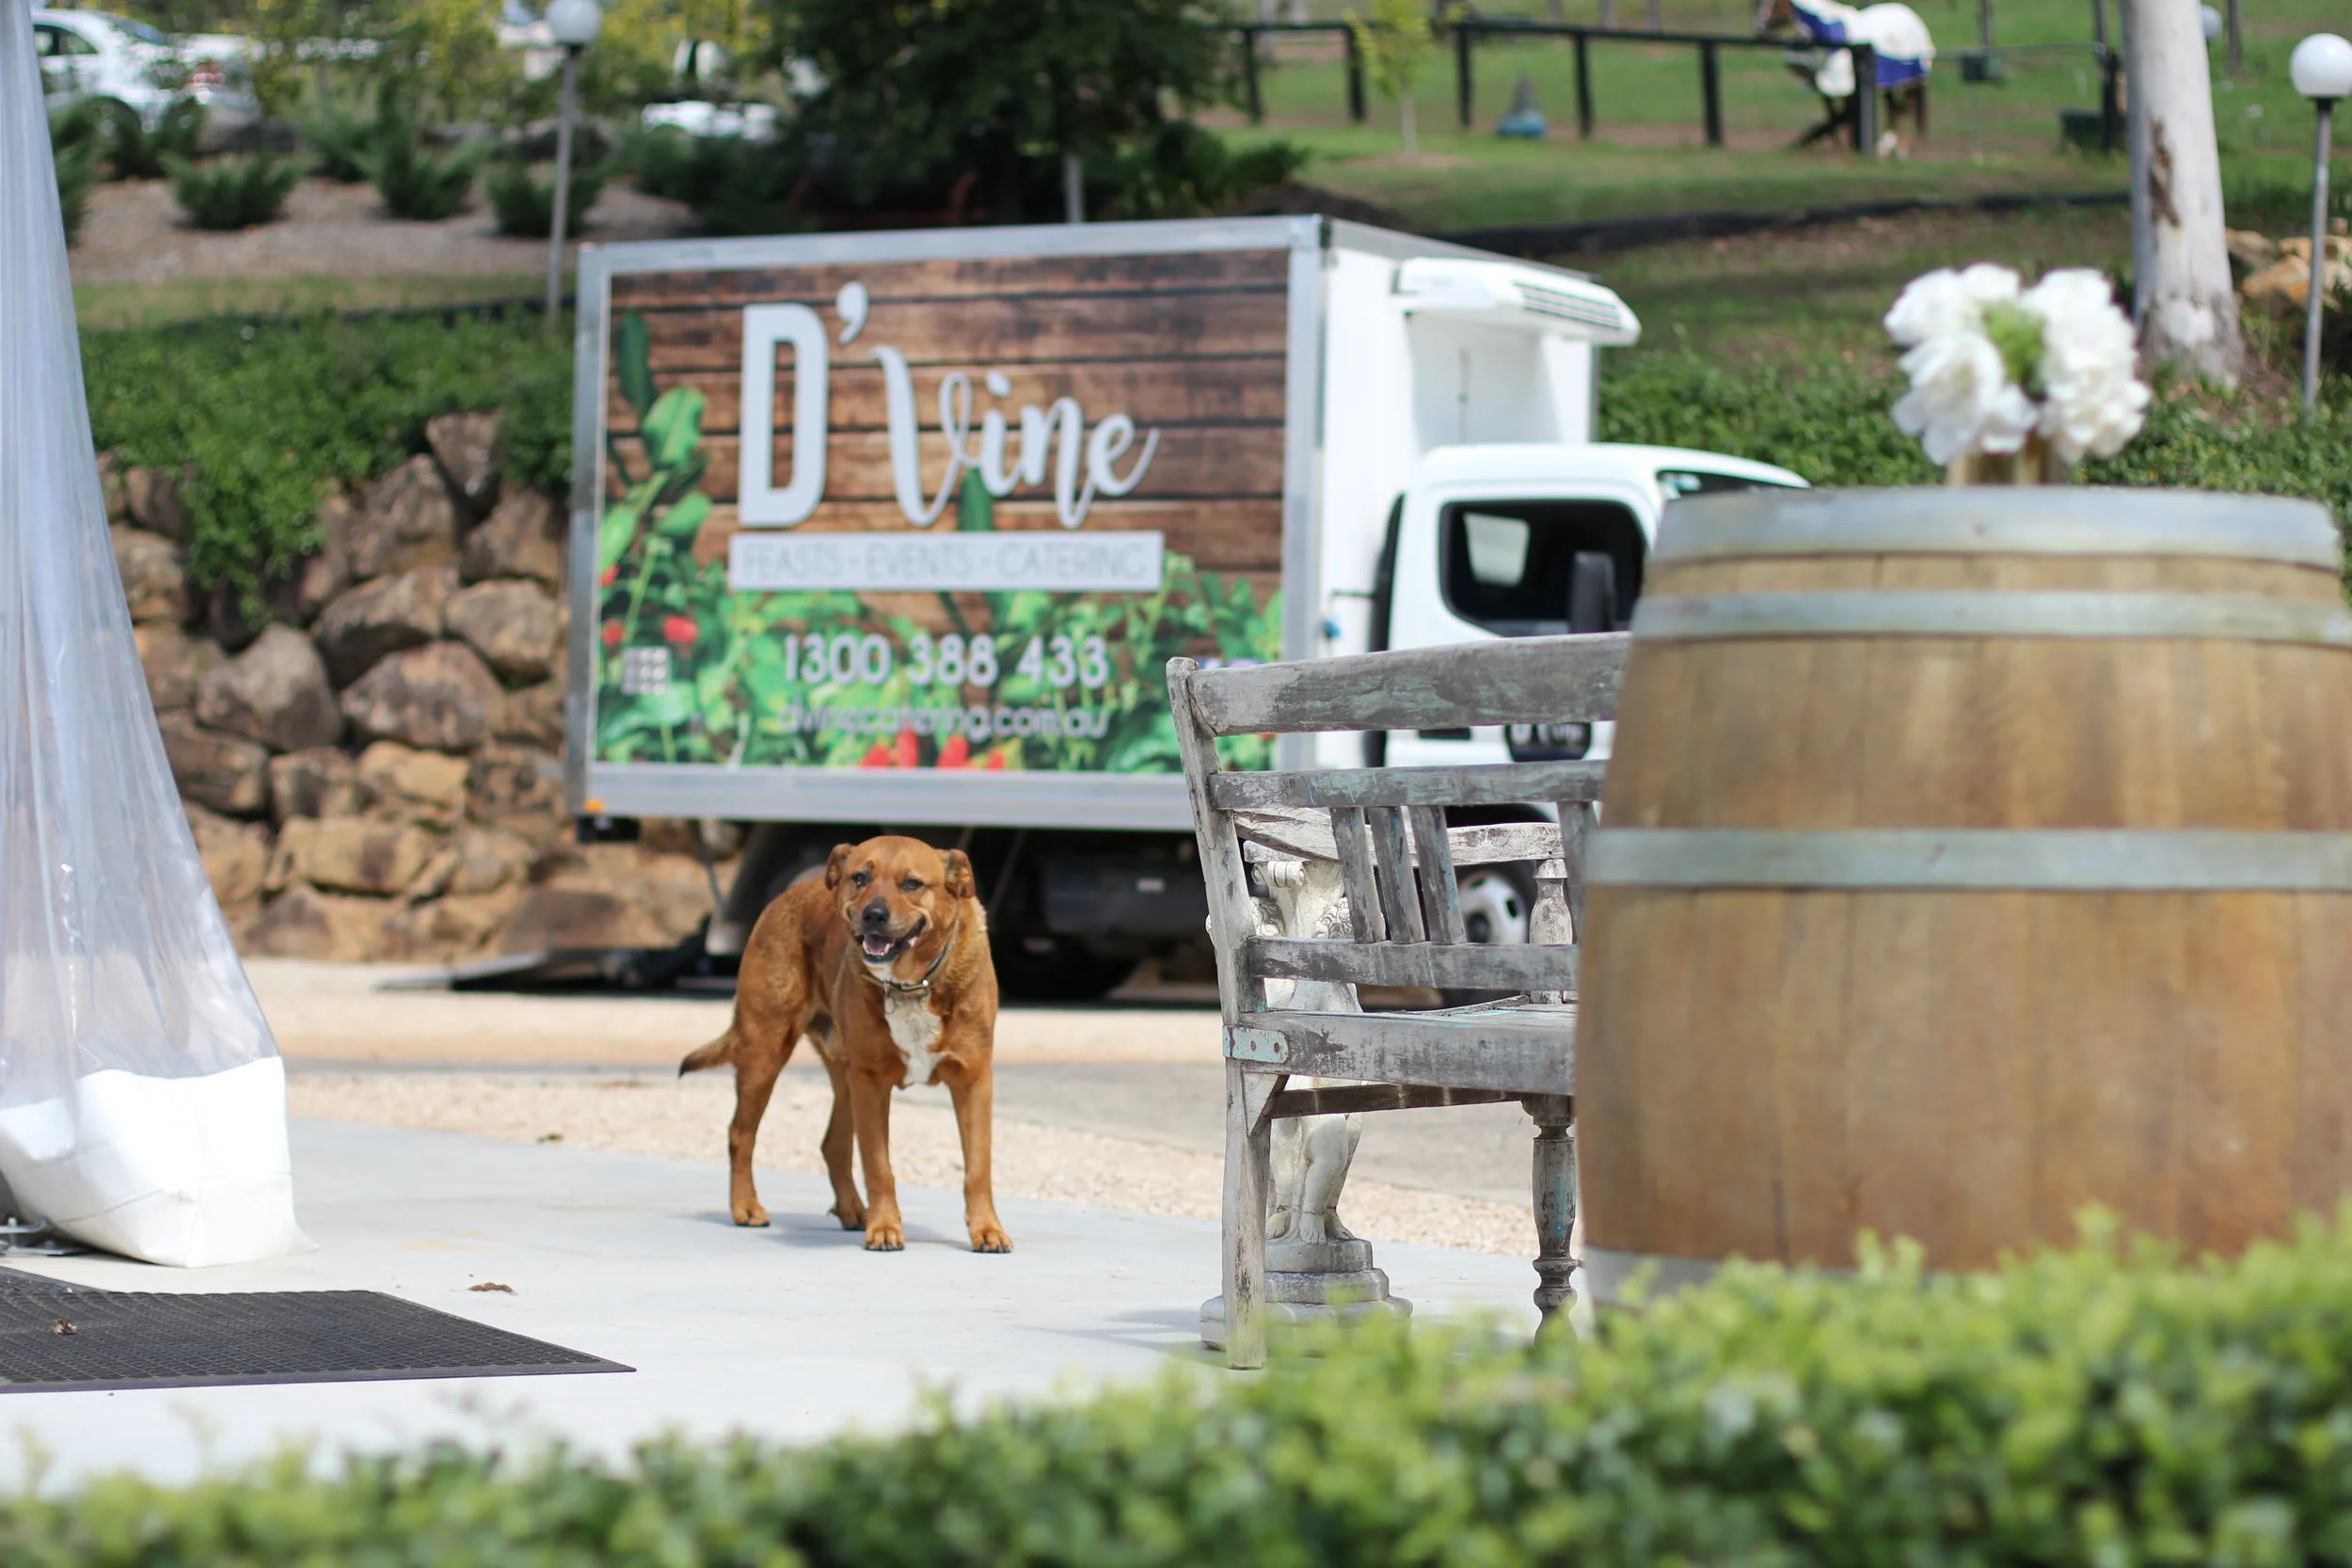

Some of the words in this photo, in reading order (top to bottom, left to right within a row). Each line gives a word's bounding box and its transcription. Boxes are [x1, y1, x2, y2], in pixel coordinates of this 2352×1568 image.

[742, 542, 844, 580] FEASTS
[865, 542, 974, 580] EVENTS
[995, 542, 1147, 580] CATERING
[785, 633, 891, 685] 1300
[907, 633, 999, 688] 388
[1016, 634, 1109, 689] 433
